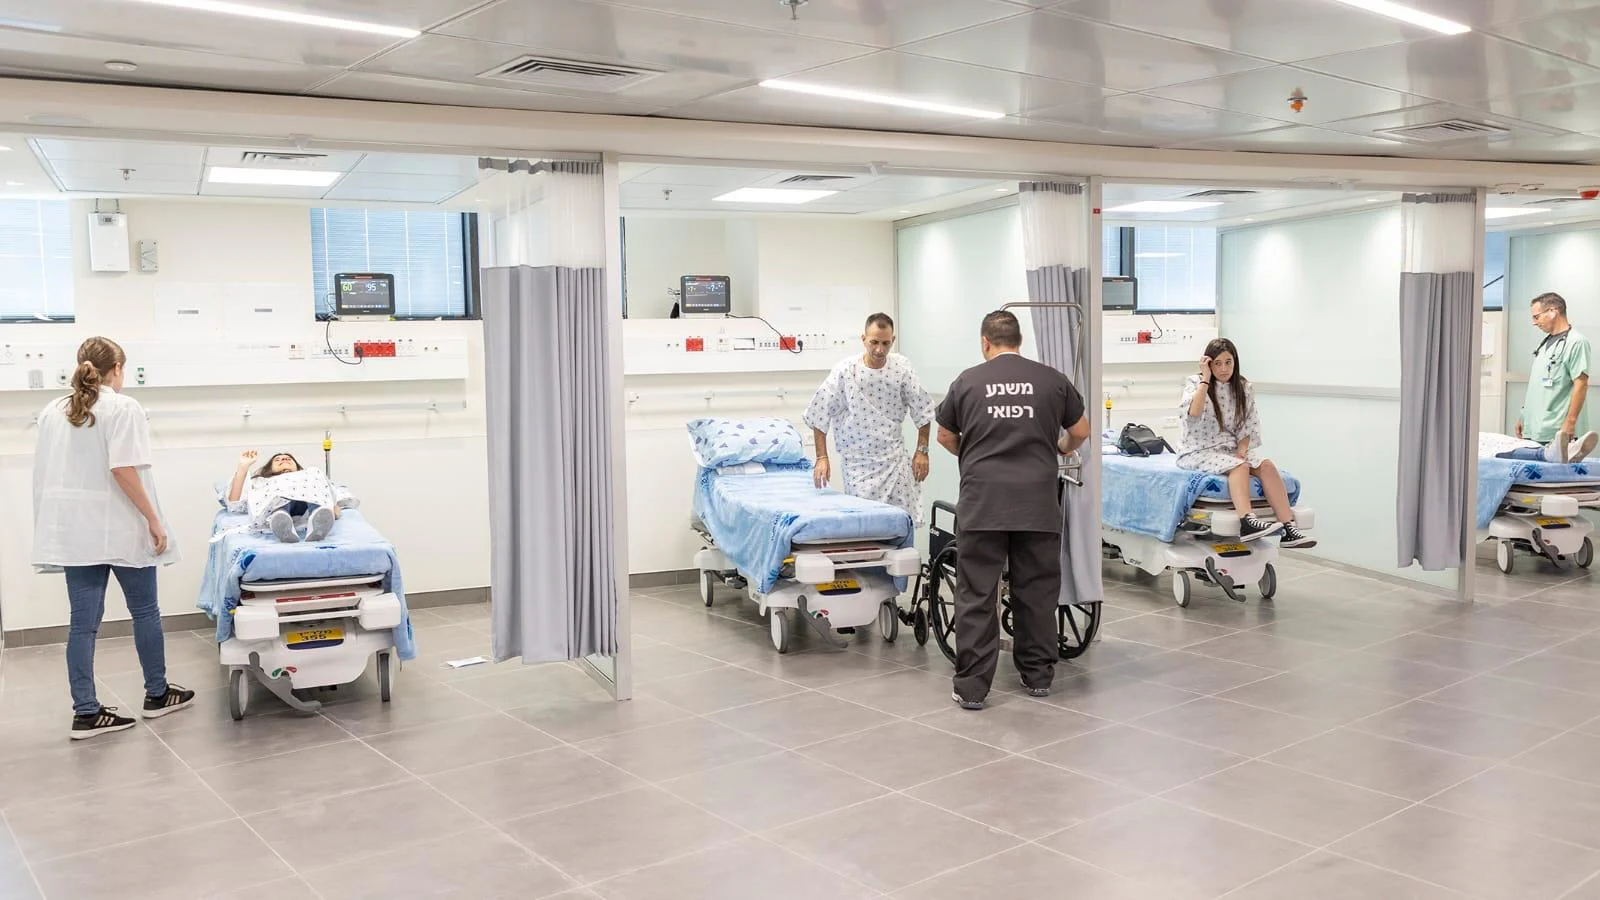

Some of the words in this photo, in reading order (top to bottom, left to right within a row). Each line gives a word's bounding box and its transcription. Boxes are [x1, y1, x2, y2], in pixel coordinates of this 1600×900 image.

[342, 282, 352, 291] 60
[985, 382, 1034, 398] משנע
[987, 405, 1034, 418] רפואי
